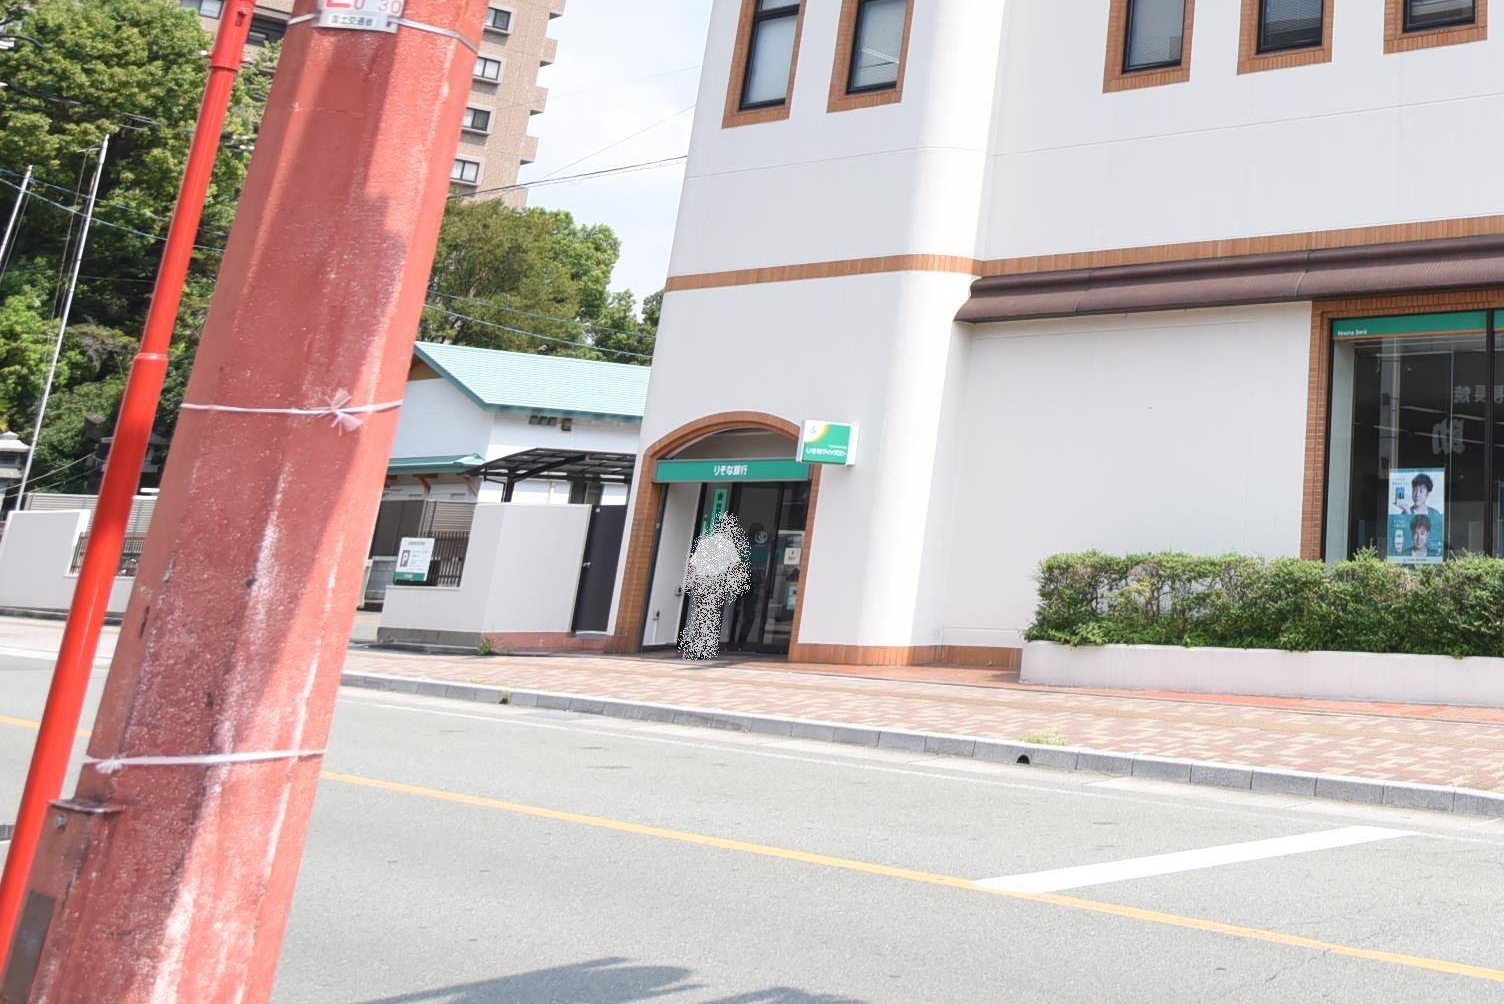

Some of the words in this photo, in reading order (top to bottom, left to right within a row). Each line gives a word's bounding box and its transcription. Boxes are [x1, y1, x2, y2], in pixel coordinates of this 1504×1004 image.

[713, 464, 748, 476] りそな銀行
